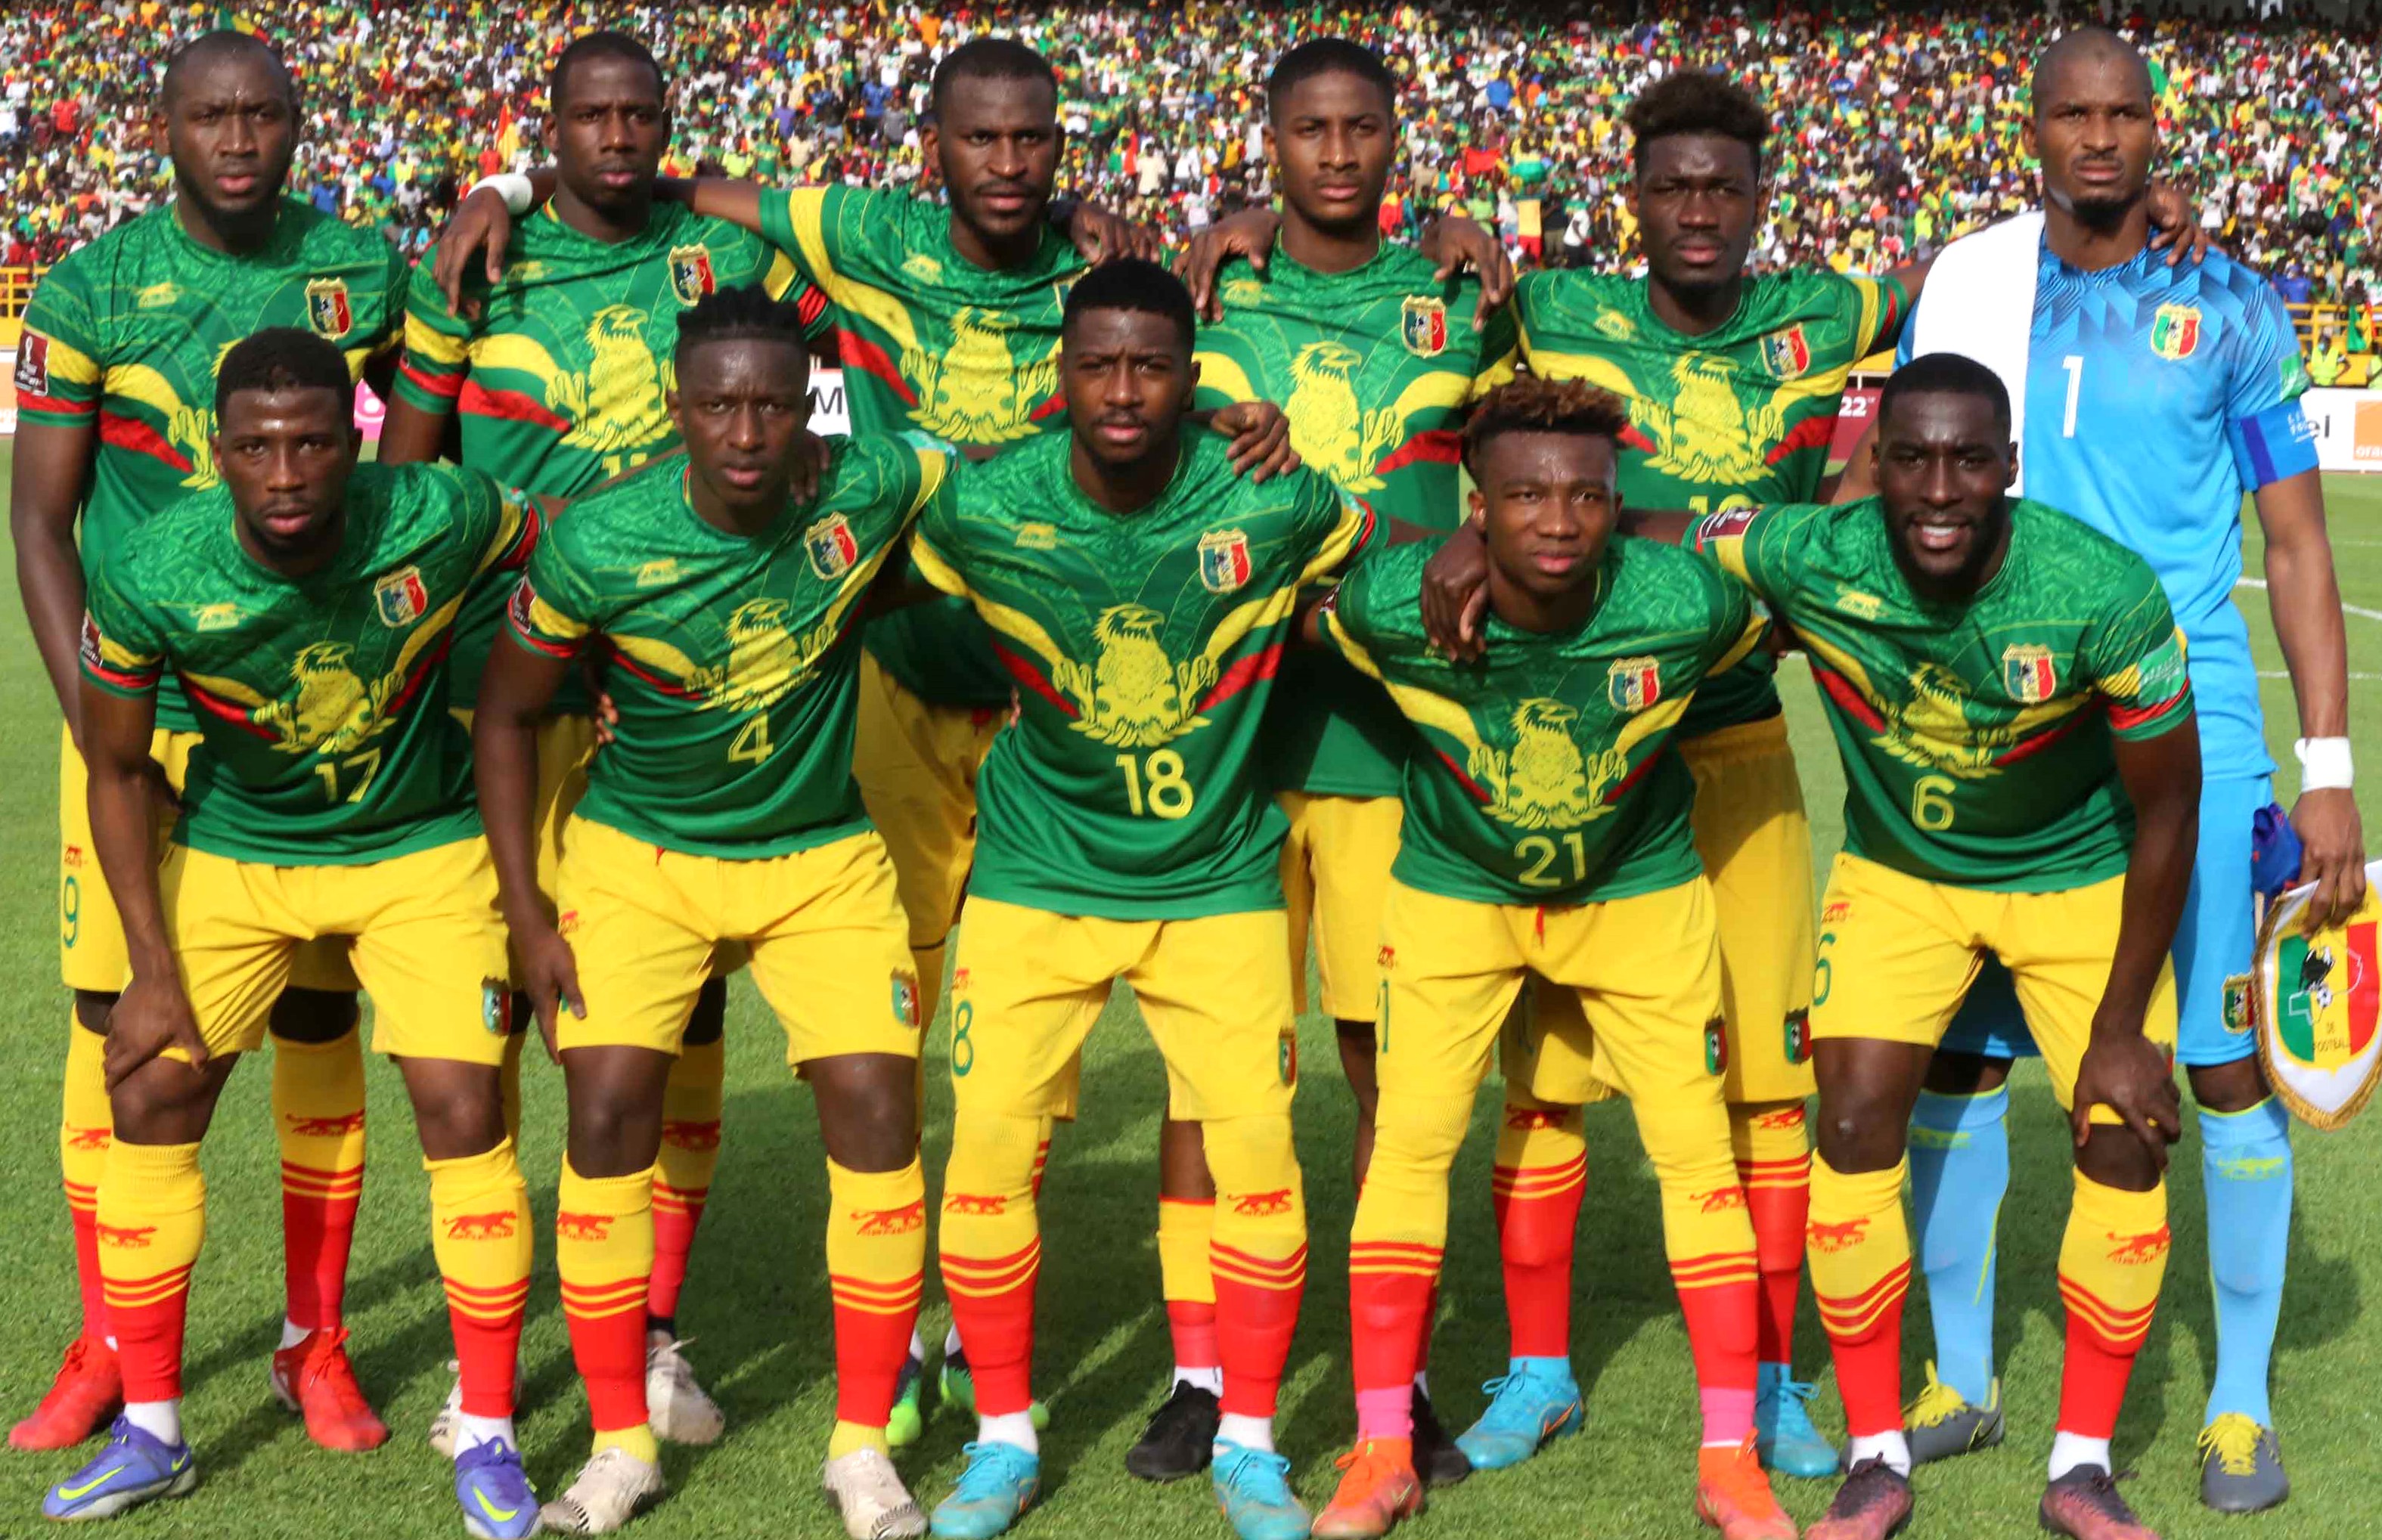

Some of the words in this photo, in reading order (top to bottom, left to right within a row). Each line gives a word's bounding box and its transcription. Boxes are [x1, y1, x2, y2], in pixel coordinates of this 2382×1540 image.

[2062, 355, 2084, 438] 1
[728, 713, 774, 764] 4
[315, 747, 381, 803] 17
[1116, 748, 1194, 819] 18
[1912, 776, 1956, 831] 6
[1514, 832, 1586, 886] 21
[64, 875, 79, 949] 9
[1814, 932, 1836, 1006] 6
[952, 999, 974, 1077] 8
